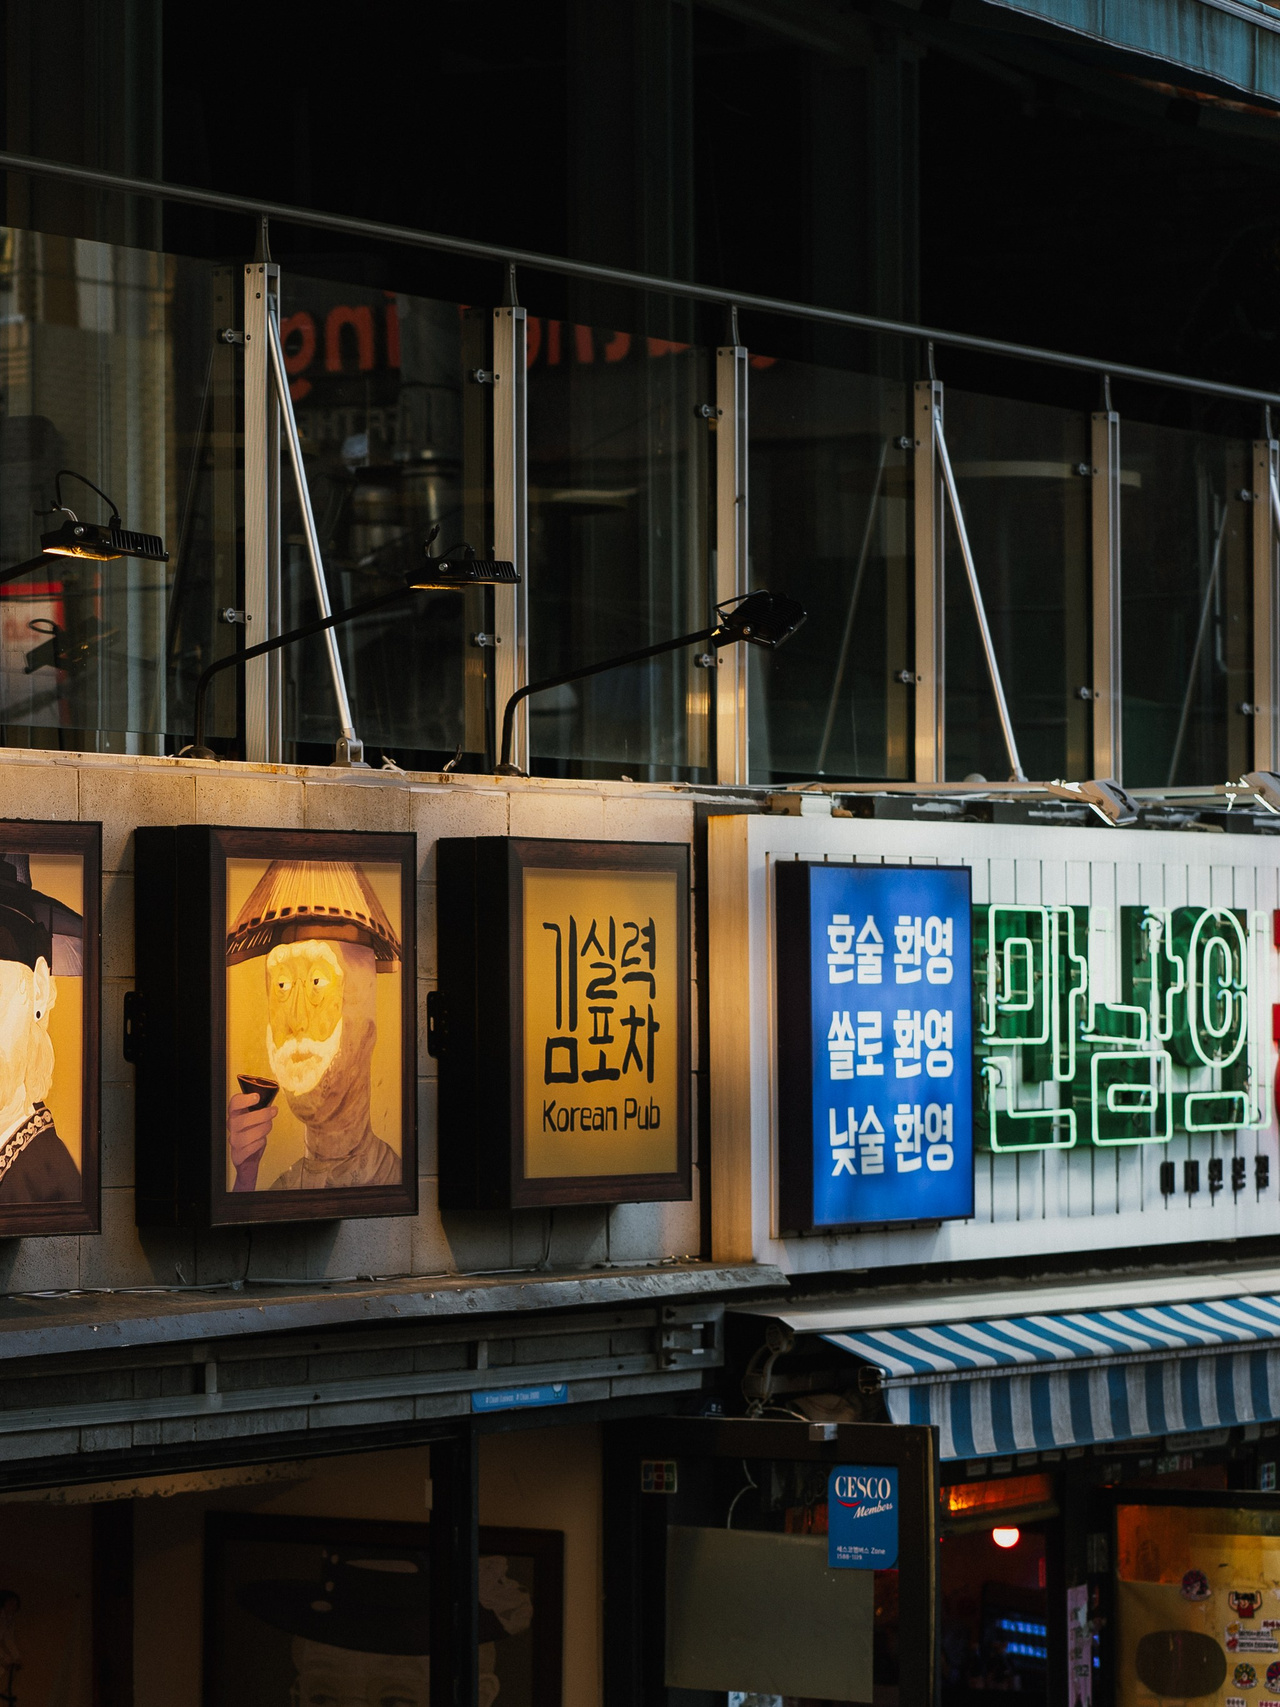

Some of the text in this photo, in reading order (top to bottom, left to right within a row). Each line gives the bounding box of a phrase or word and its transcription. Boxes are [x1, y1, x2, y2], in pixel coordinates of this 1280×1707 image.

[827, 914, 954, 985] 혼술 환영
[827, 1008, 954, 1081] 쏠로 환영
[981, 903, 1272, 1153] 만남의
[543, 1095, 661, 1133] Korean Pub
[829, 1102, 954, 1177] 낮술 환영
[835, 1475, 891, 1500] CESCO
[853, 1500, 893, 1519] Members
[871, 1546, 886, 1555] Zone
